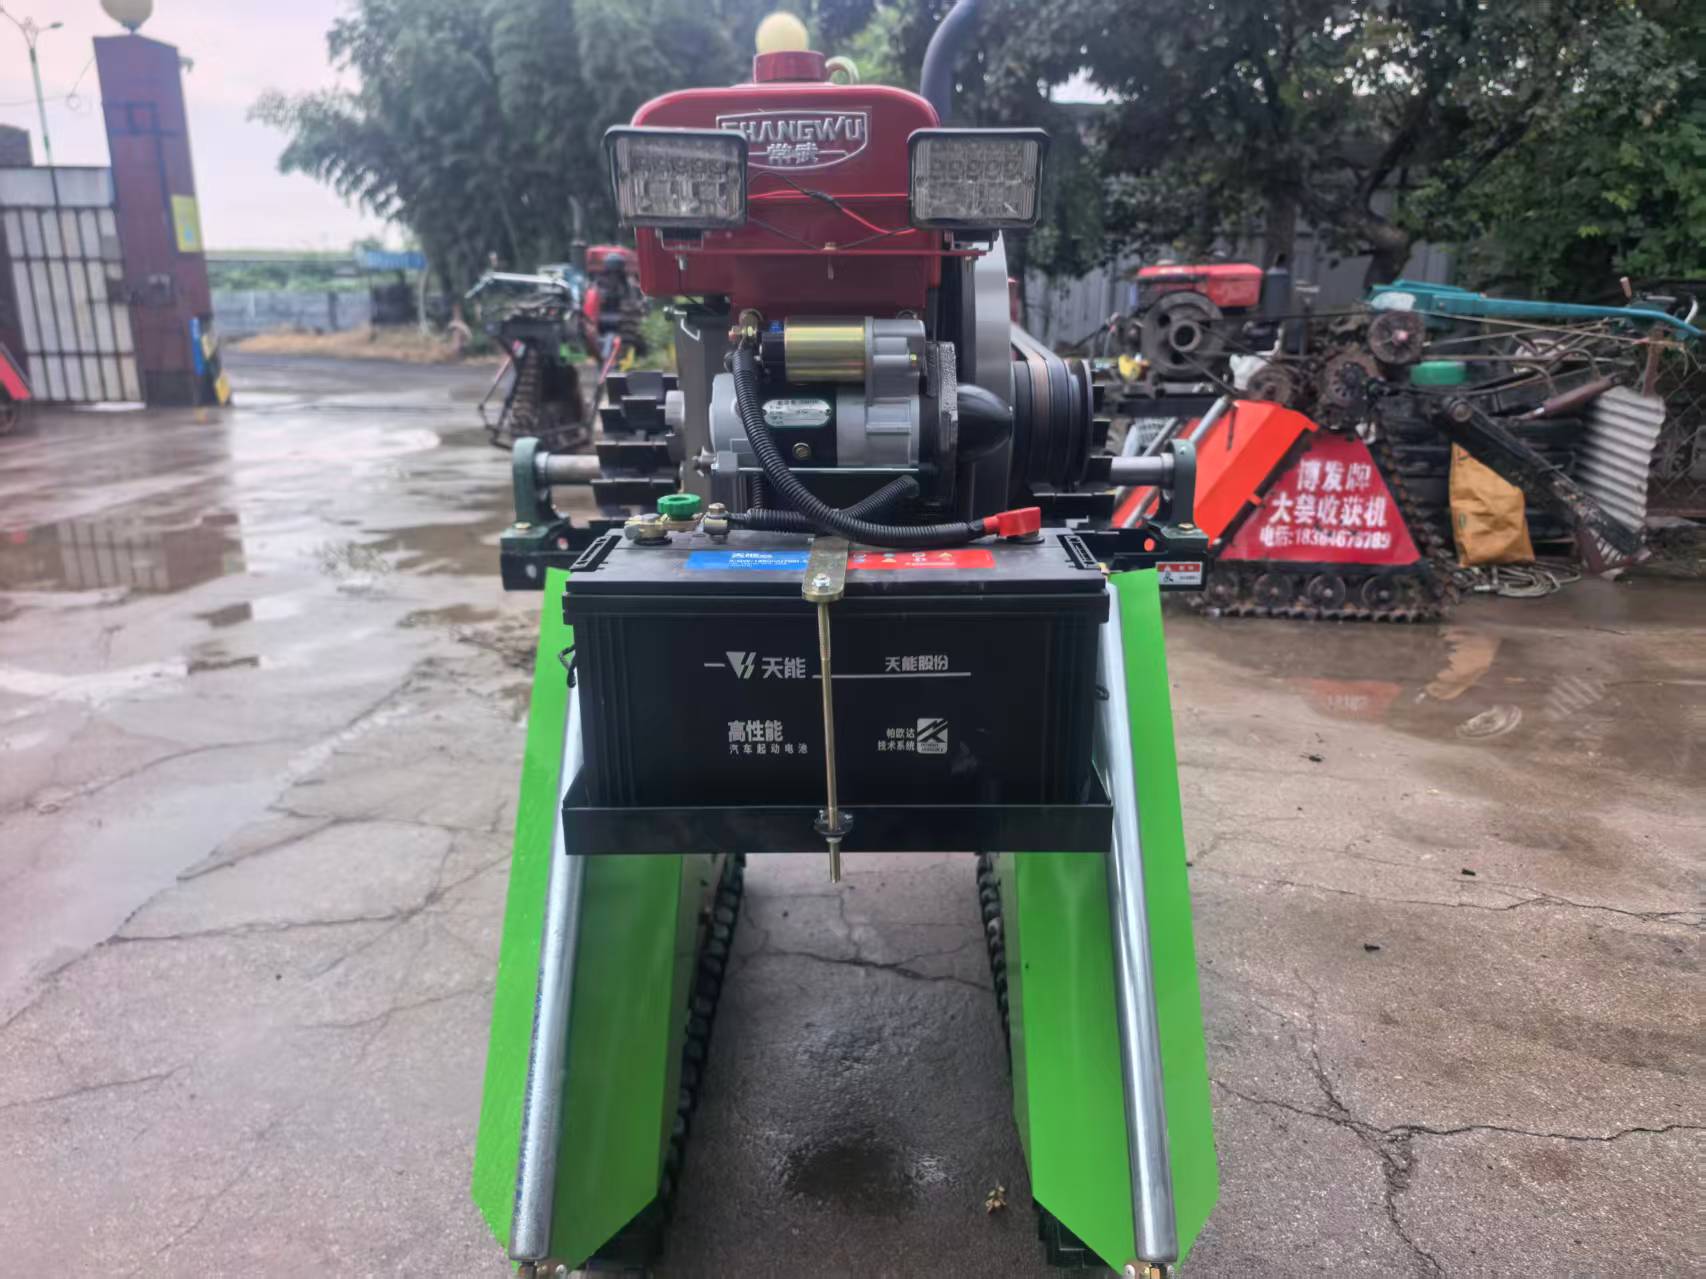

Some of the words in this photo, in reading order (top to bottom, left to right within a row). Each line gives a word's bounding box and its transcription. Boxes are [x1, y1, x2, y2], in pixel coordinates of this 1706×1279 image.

[761, 656, 807, 679] 天能
[885, 655, 949, 673] 天能股份
[728, 719, 784, 742] 高性能
[729, 743, 808, 755] 汽车起动电池
[878, 739, 915, 751] 技术系统
